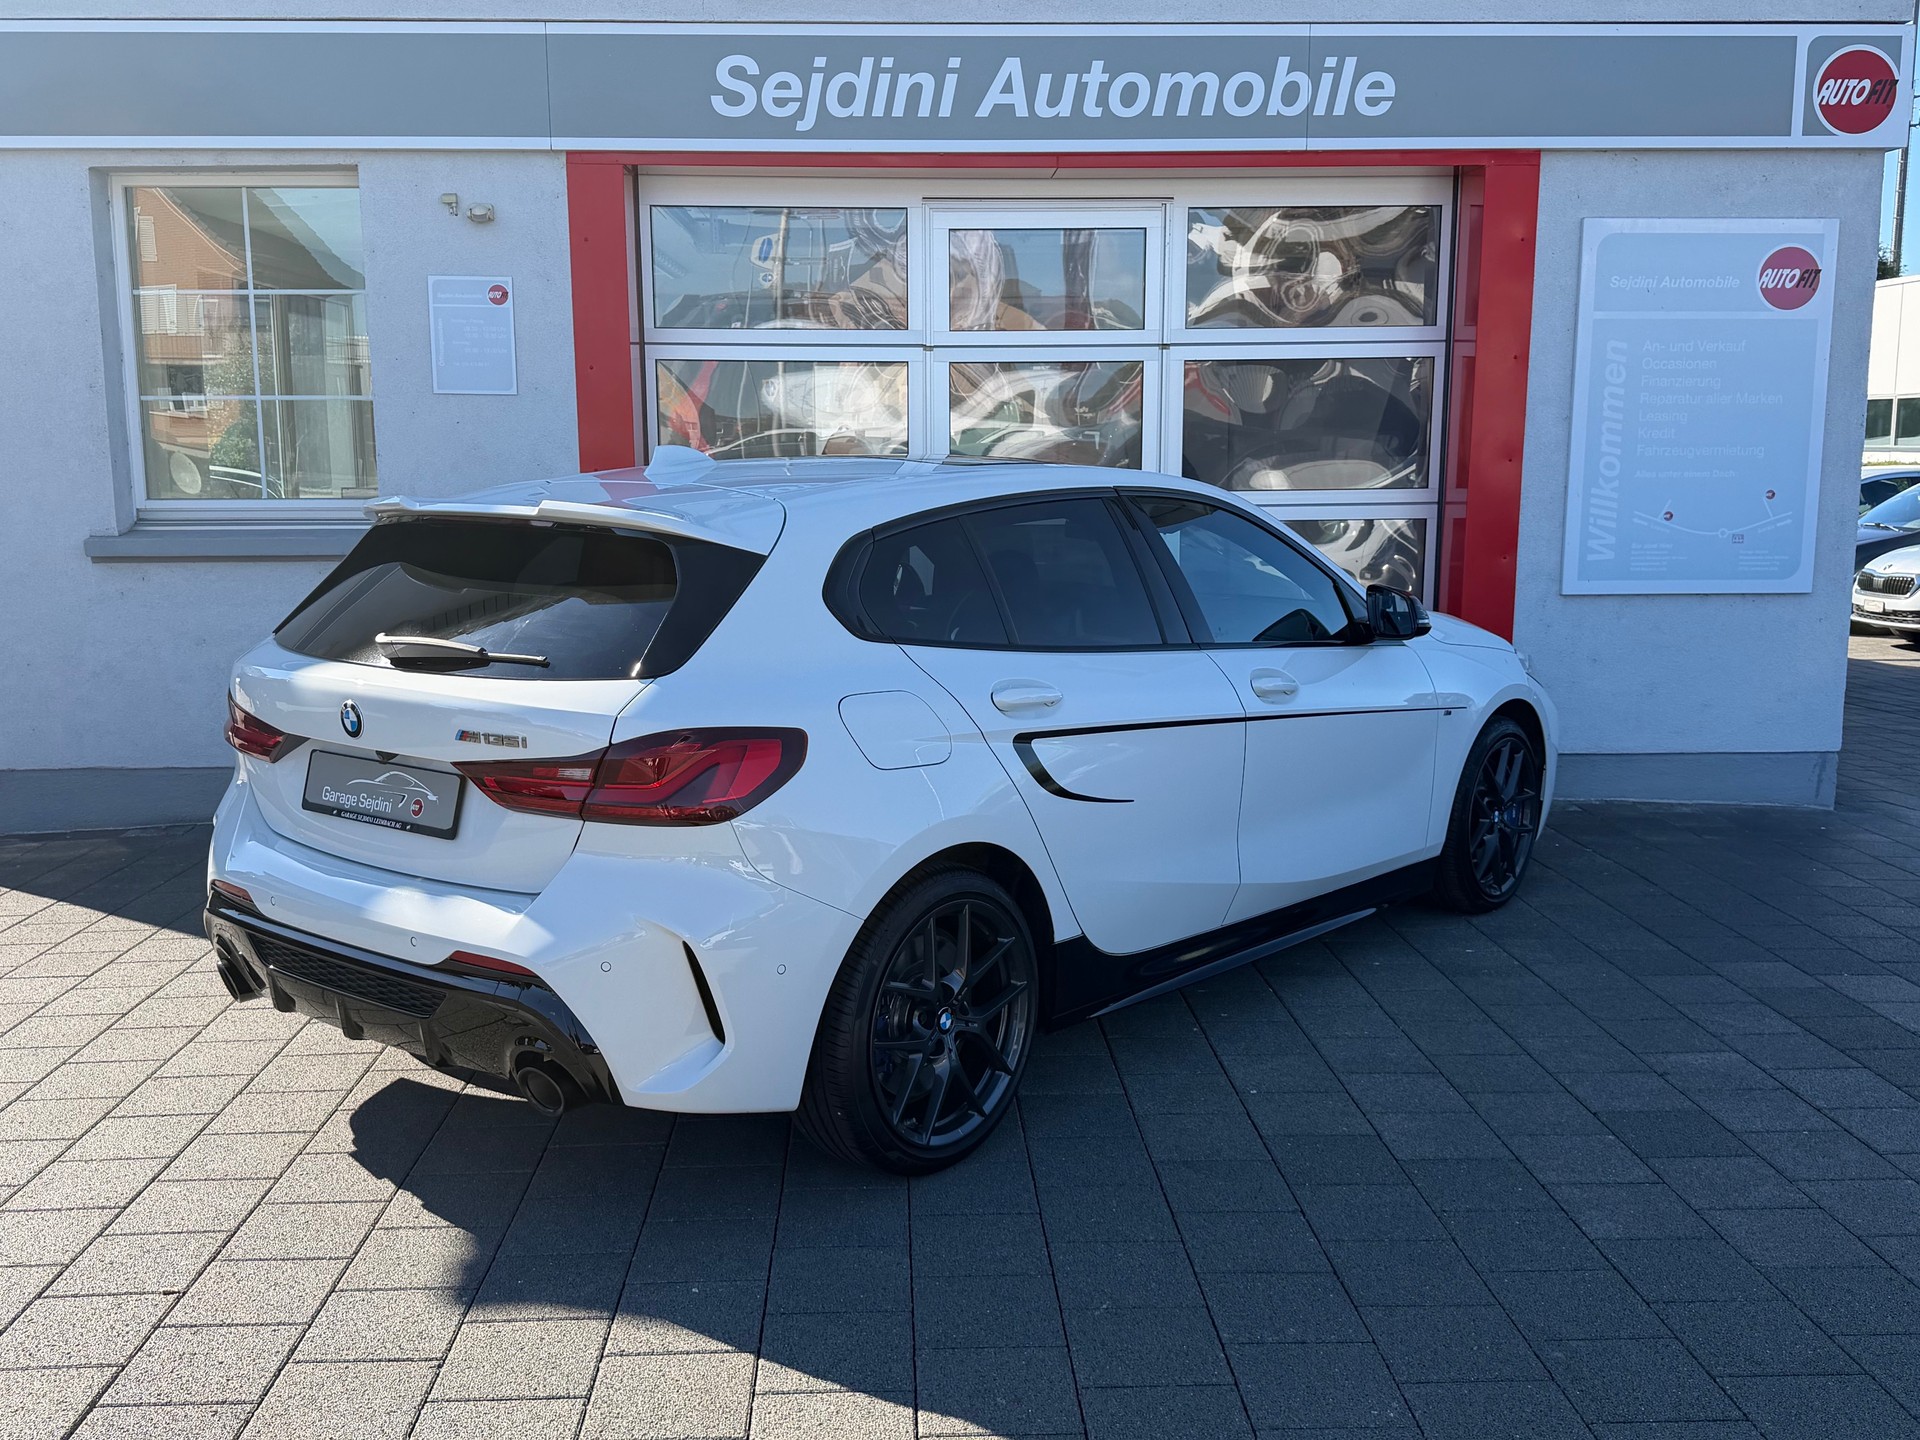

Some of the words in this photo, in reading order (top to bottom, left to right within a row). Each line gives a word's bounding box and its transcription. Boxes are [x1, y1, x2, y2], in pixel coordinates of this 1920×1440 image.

[710, 54, 962, 131] Sejdini
[975, 56, 1397, 118] Automobile
[1817, 78, 1899, 106] AUTOFIT
[1610, 275, 1657, 291] Sejdini
[1660, 275, 1740, 289] Automobile
[1759, 268, 1822, 289] AUTOFIT
[1642, 340, 1665, 352] An-
[1670, 340, 1693, 352] und
[1698, 339, 1747, 352] Verkauf
[1642, 357, 1717, 370] Occasionen
[1640, 375, 1721, 388] Finanzierung
[1639, 393, 1701, 406] Reparatur
[1706, 393, 1732, 405] aller
[1736, 393, 1783, 405] Marken
[1638, 410, 1688, 424] Leasing
[1637, 427, 1675, 440] Kredit
[1587, 339, 1628, 561] Willkommen
[1636, 444, 1765, 458] Fahrzeugvermietung
[322, 786, 357, 809] Garage
[358, 793, 393, 813] Sejdini
